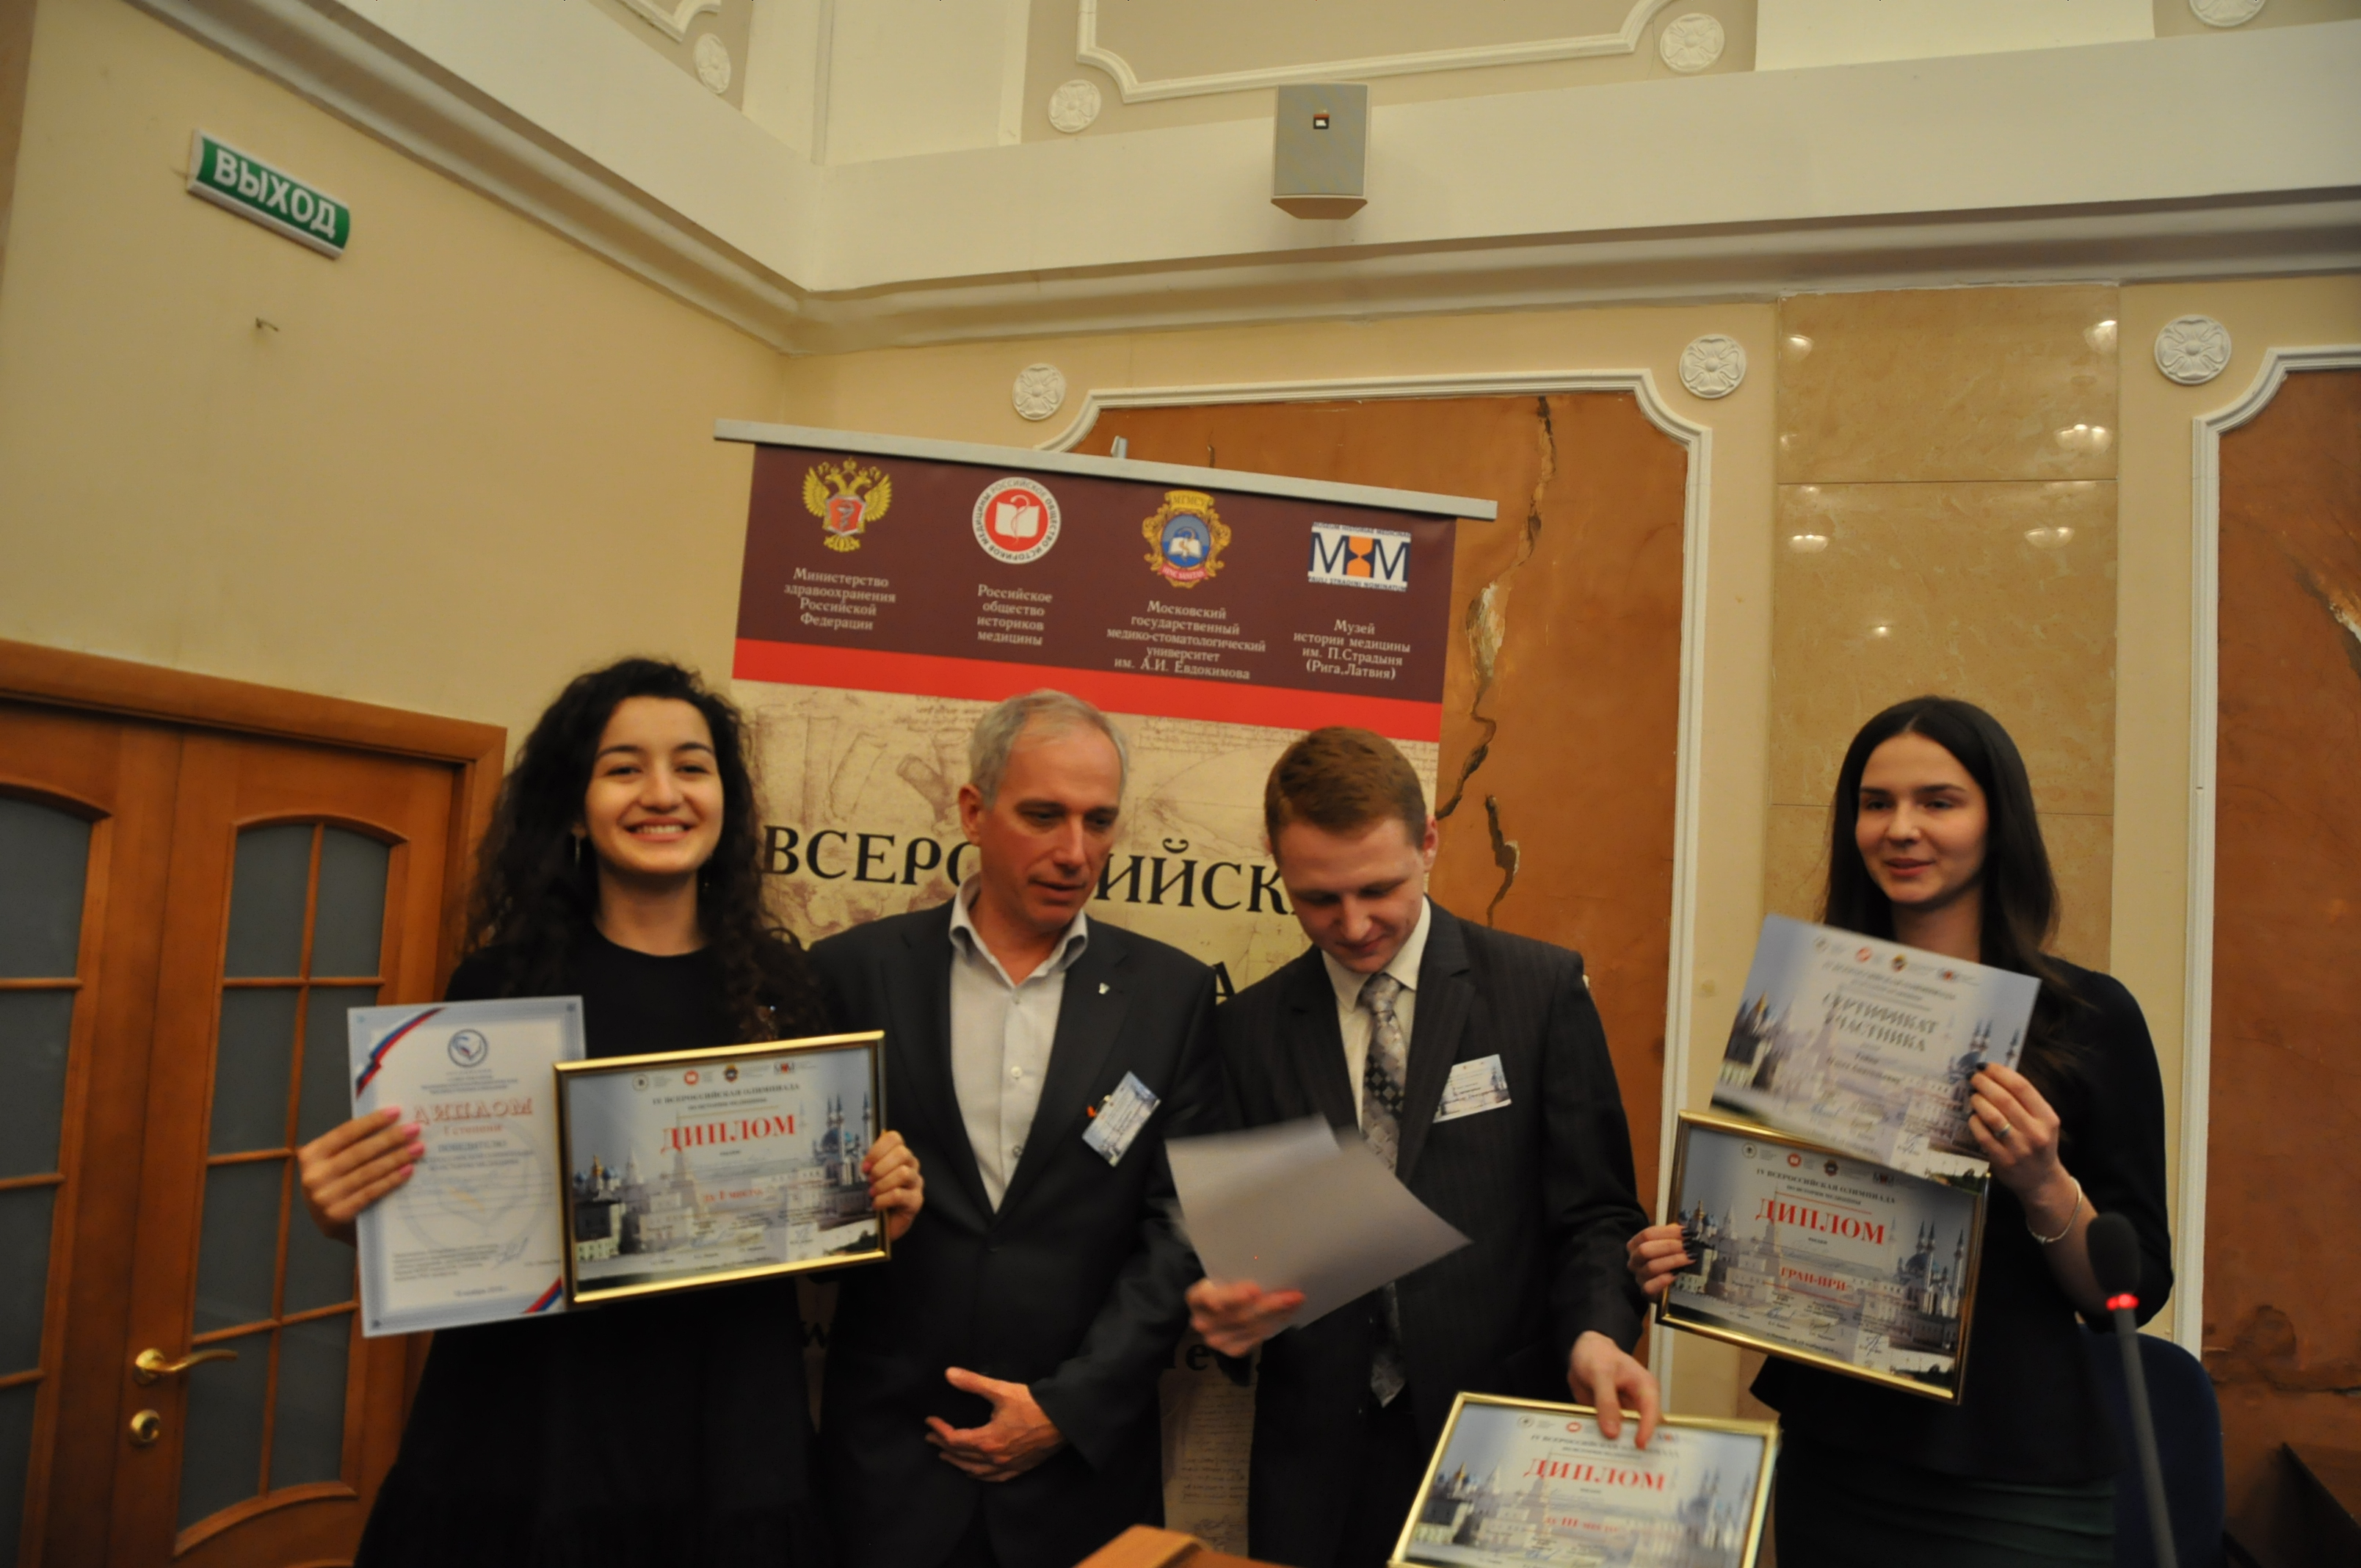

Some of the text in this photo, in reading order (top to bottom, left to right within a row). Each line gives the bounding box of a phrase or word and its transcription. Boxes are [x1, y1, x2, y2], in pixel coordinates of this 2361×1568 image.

[213, 148, 337, 240] ВЫХОД
[992, 479, 1047, 496] РОССИЙСКОЕ
[1042, 497, 1059, 548] ОБЩЕСТВО
[793, 567, 889, 588] Министерство
[784, 584, 896, 603] здравоохранения
[977, 584, 1053, 603] Российское
[799, 597, 877, 616] Российской
[982, 600, 1045, 616] общество
[1147, 600, 1227, 620] Московский
[800, 611, 874, 631] Федерации
[977, 616, 1045, 631] историков
[1131, 616, 1240, 635] государственный
[1333, 619, 1375, 636] Музей
[977, 631, 1042, 646] медицины
[1106, 628, 1266, 652] медико-стоматологический
[1294, 632, 1411, 653] истории медицины
[1147, 646, 1220, 662] университет
[1302, 647, 1403, 667] им. П.Страдыня
[1114, 657, 1250, 680] им. А.И. Евдокимова
[413, 1097, 533, 1125] ДИПЛОМ
[660, 1114, 795, 1154] ДИПЛОМ
[1755, 1198, 1885, 1245] ДИПЛОМ
[1780, 1266, 1849, 1292] ГРАН-ПРИ
[1523, 1457, 1666, 1492] ДИПЛОМ
